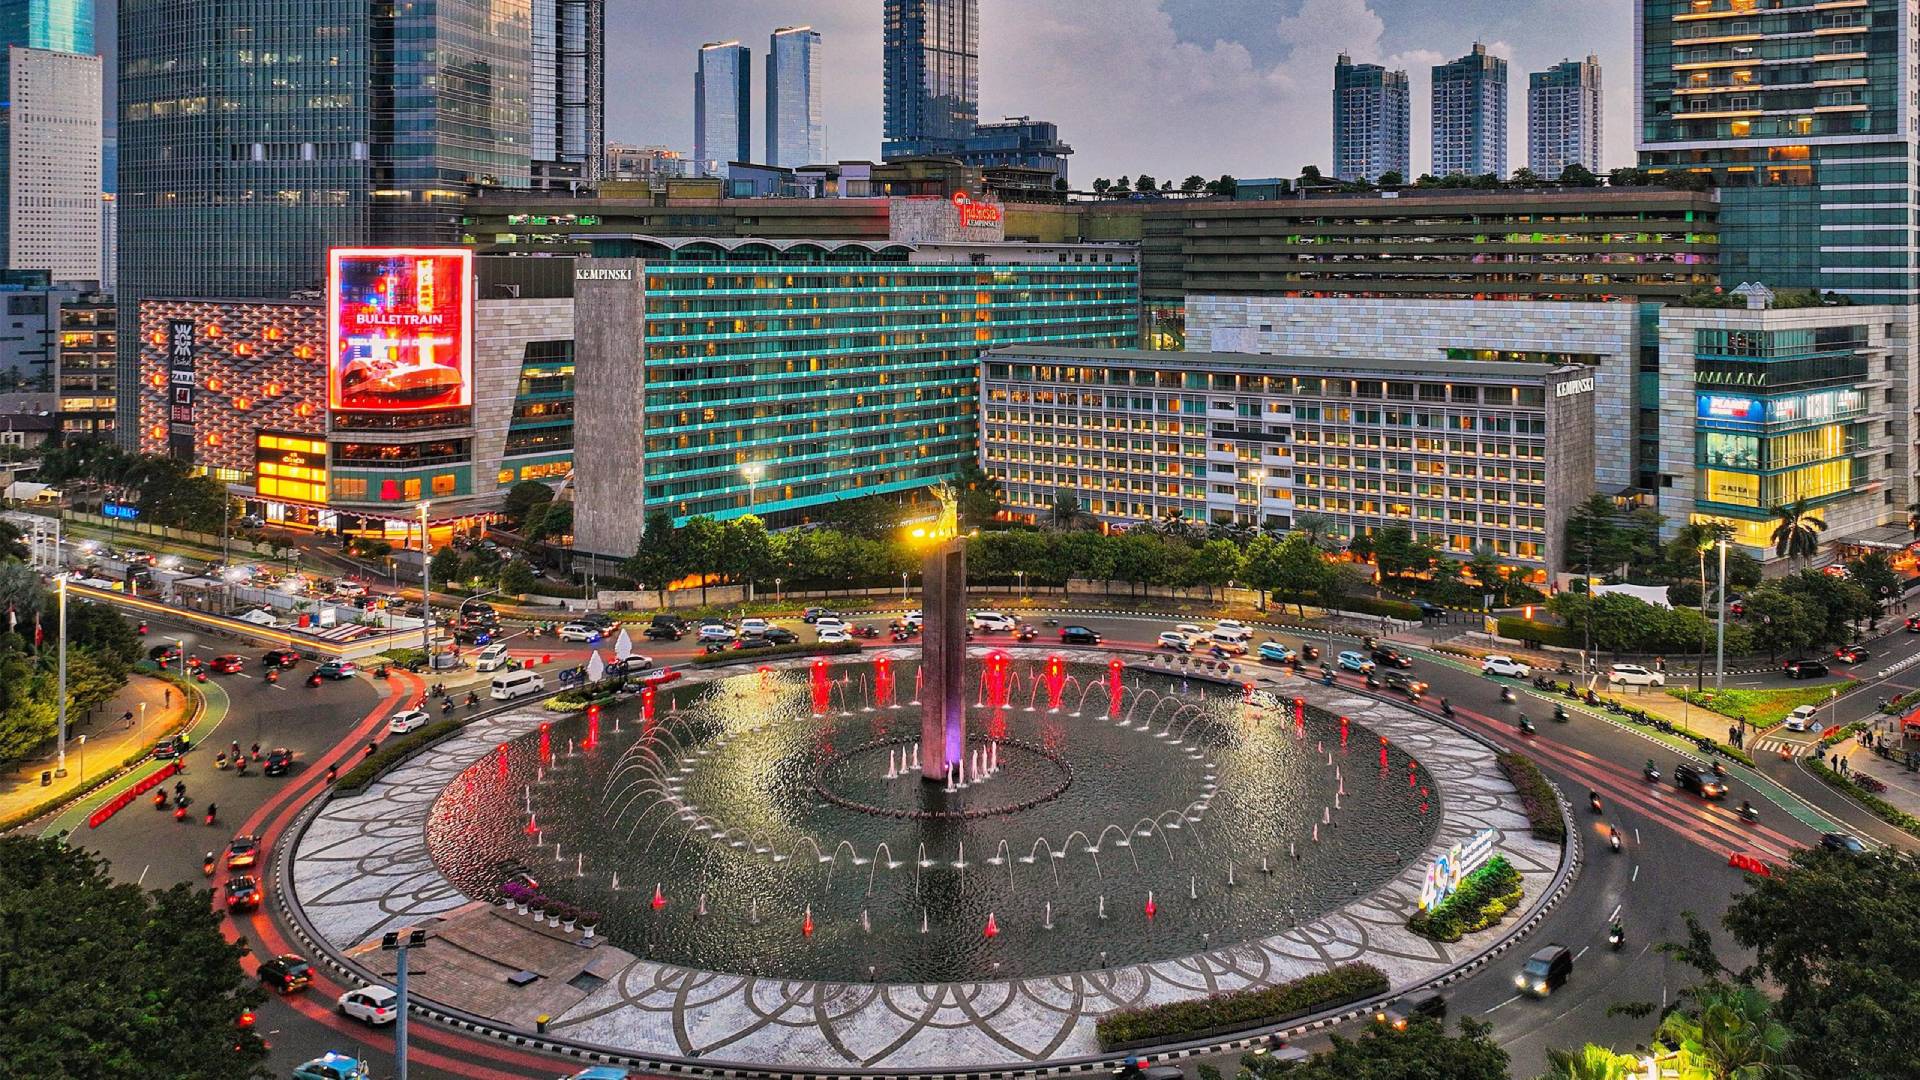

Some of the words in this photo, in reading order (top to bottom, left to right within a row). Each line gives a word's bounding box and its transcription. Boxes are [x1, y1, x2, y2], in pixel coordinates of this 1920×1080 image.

[576, 269, 633, 281] KEMPINSKI
[356, 314, 401, 325] BULLET
[401, 314, 443, 325] TRAIN
[172, 372, 193, 383] ZARA
[1556, 377, 1594, 398] KEMPINSKI
[1420, 842, 1462, 912] 495
